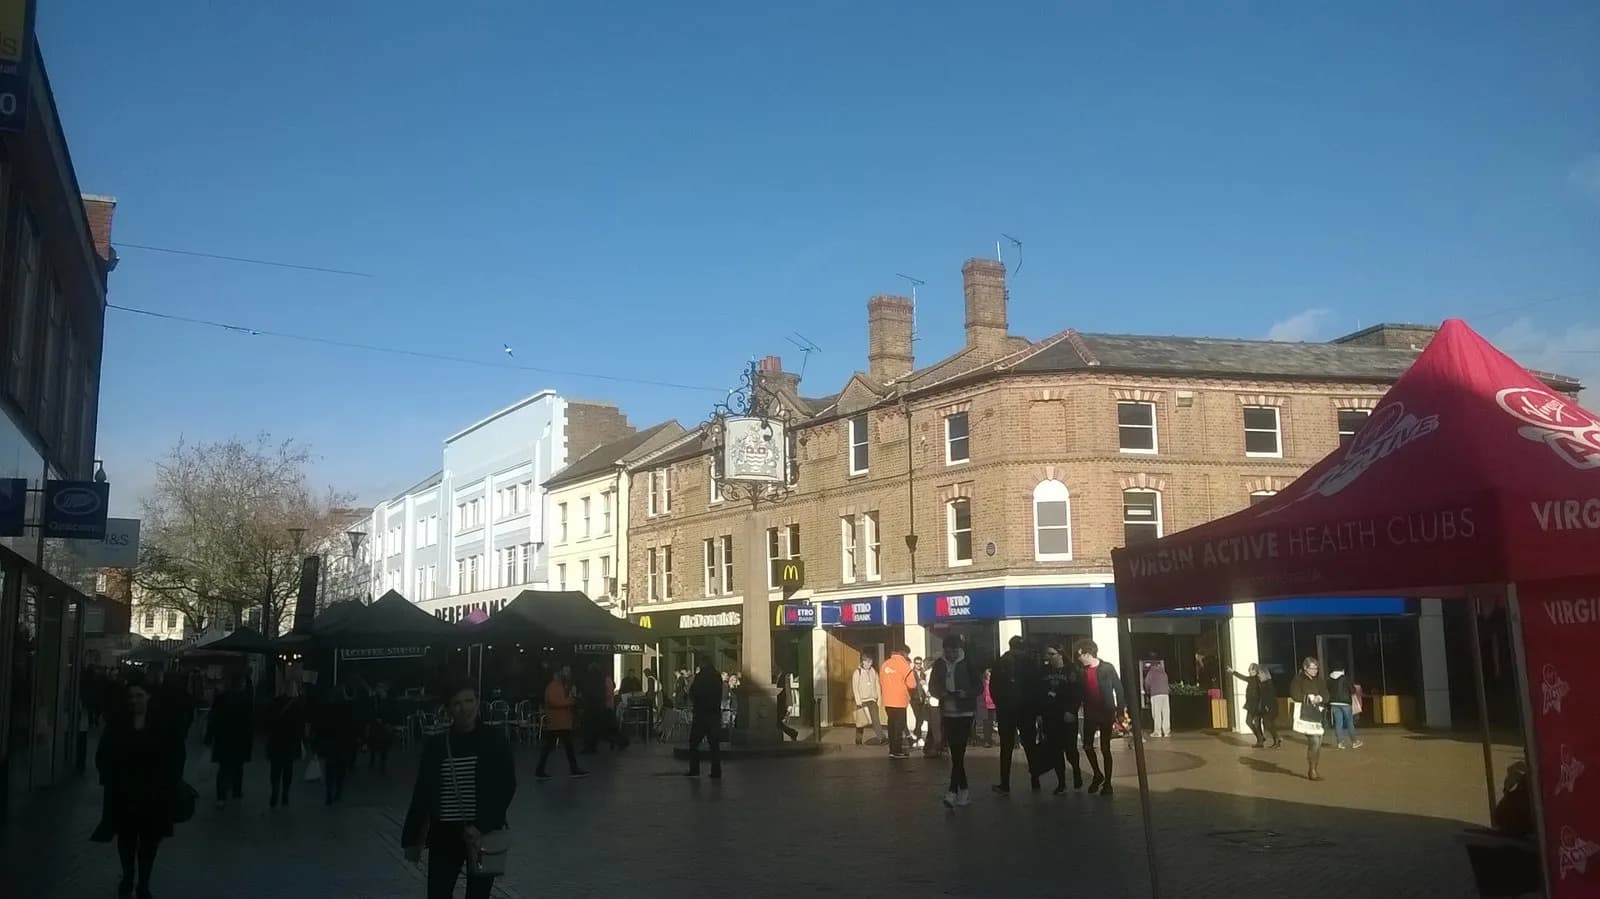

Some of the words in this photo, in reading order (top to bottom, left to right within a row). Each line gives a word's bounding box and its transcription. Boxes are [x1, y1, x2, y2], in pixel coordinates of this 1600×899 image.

[1128, 545, 1195, 580] VIRGIN
[1202, 532, 1280, 568] ACTIVE
[1288, 519, 1377, 556] HEALTH
[1386, 508, 1476, 545] CLUBS
[680, 611, 741, 629] McDonald's
